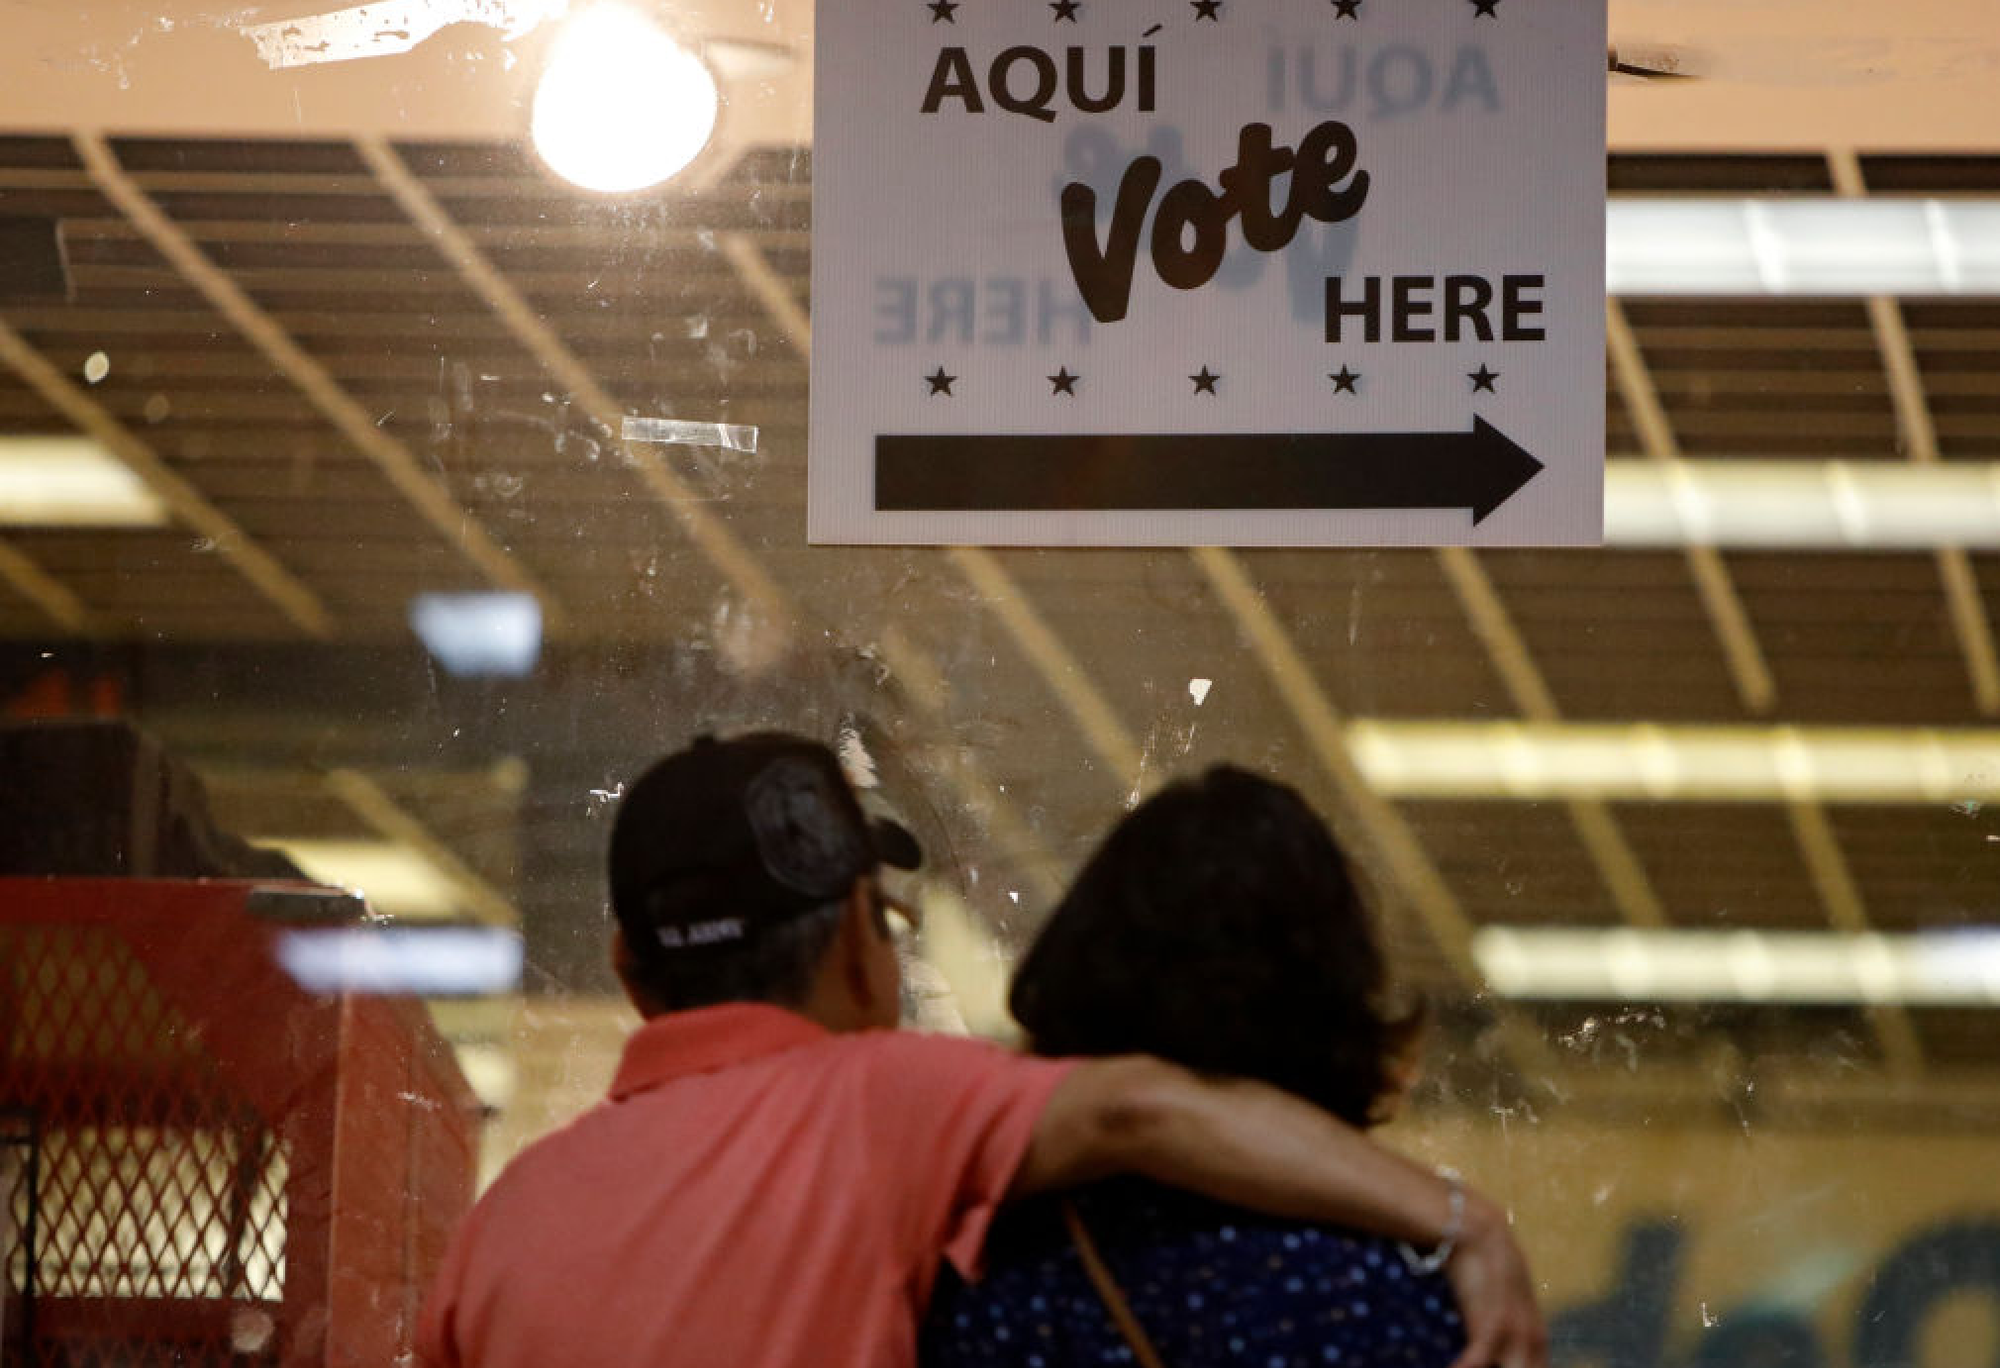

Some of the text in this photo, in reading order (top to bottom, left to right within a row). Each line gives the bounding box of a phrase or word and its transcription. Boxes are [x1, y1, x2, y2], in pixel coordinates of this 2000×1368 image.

[920, 23, 1163, 124] AQUÍ
[1060, 120, 1371, 324] Vote
[1324, 274, 1546, 343] HERE
